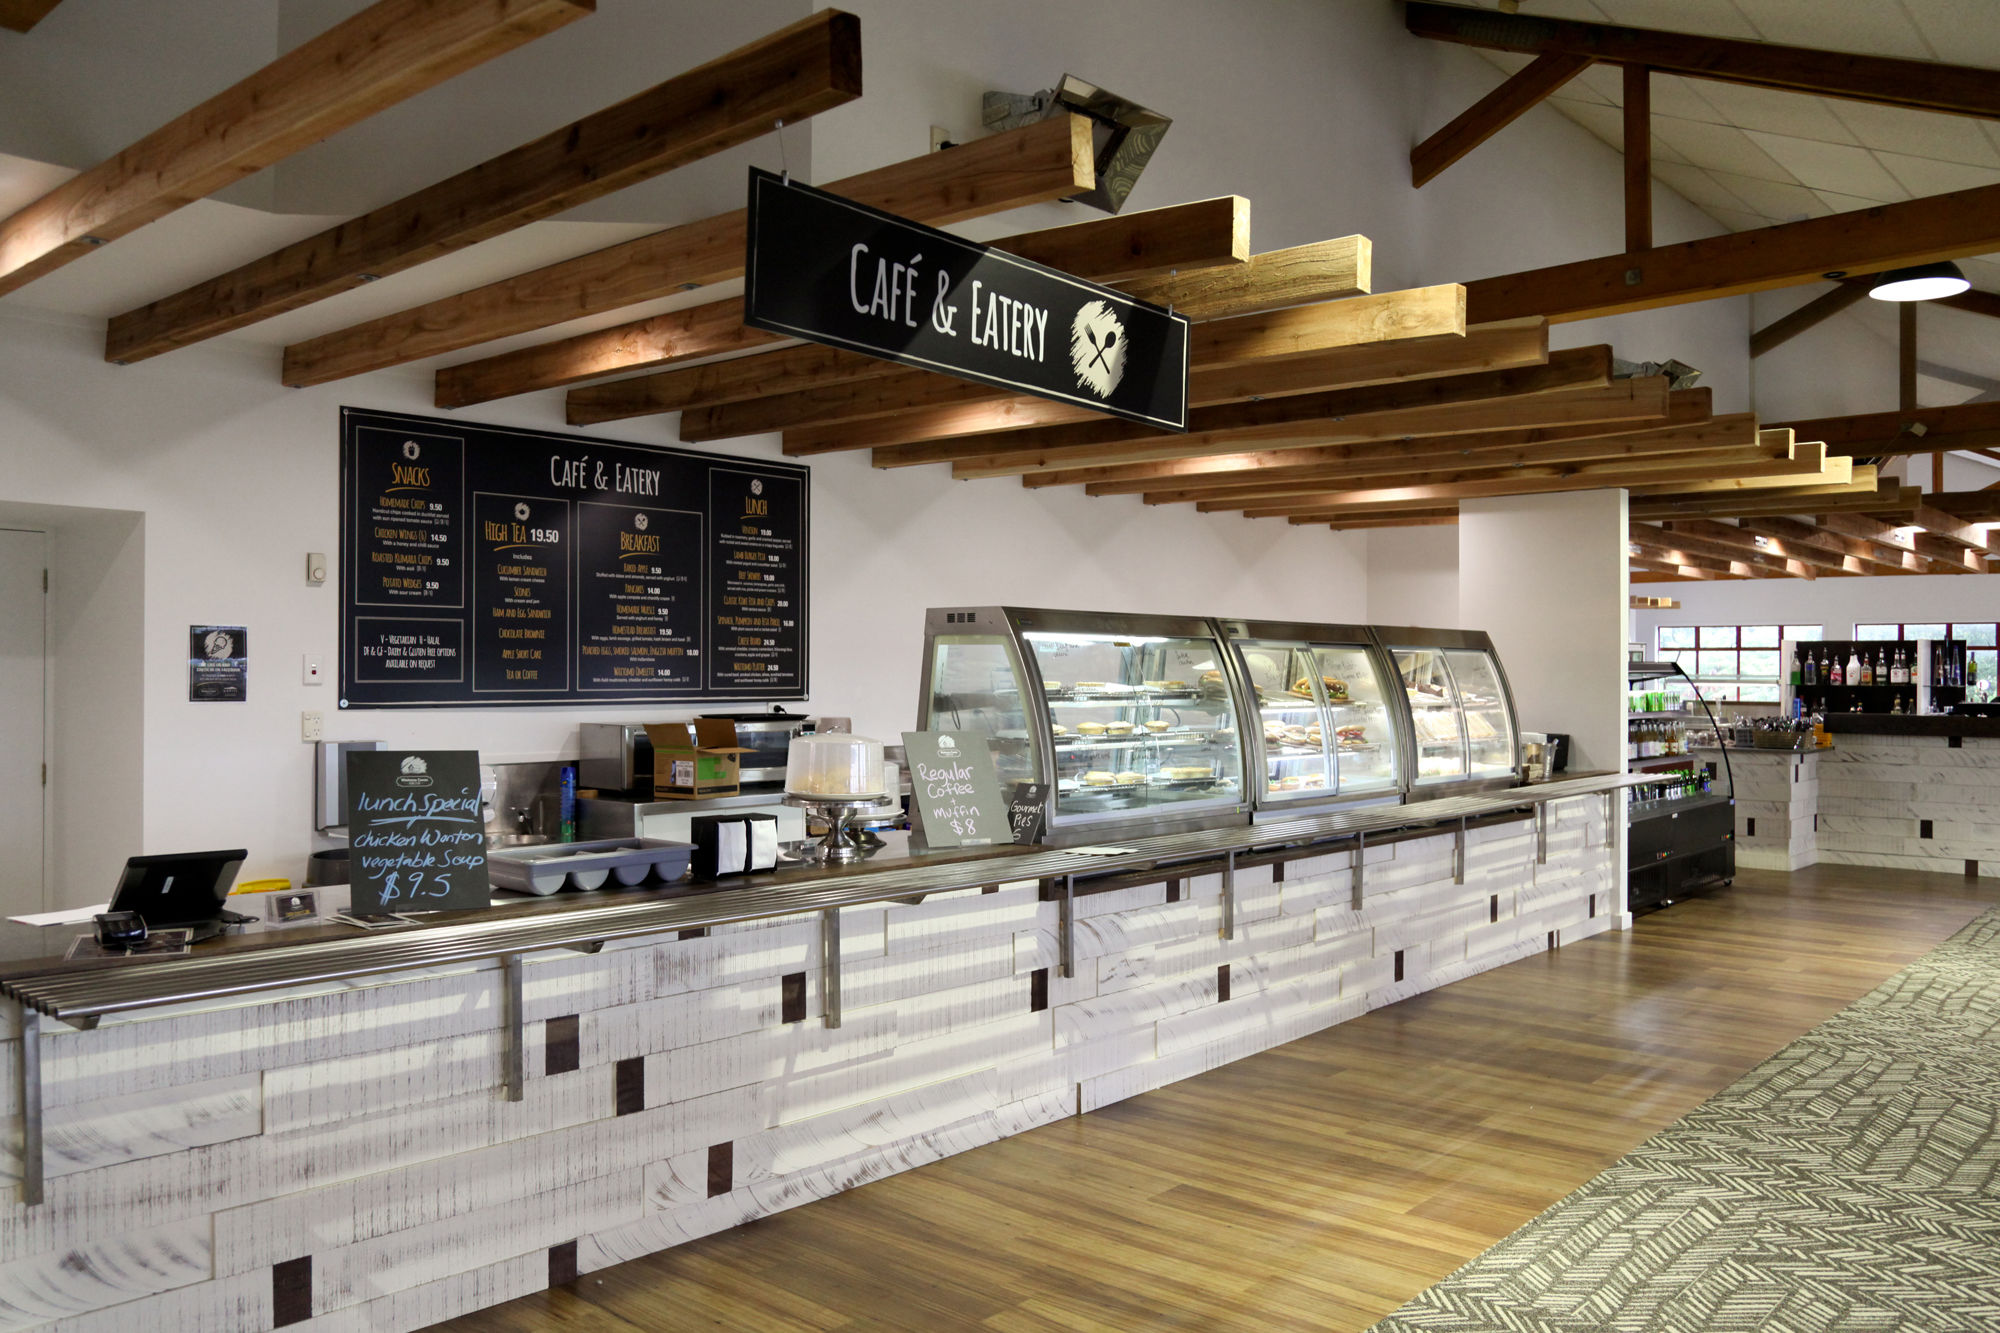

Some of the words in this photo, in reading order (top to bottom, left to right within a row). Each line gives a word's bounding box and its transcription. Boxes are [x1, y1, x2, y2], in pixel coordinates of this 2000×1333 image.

[850, 243, 923, 329] CAFÉ
[932, 270, 958, 337] &
[971, 281, 1049, 364] EATERY
[392, 462, 431, 487] SNACKS
[551, 455, 589, 489] CAFÉ
[594, 460, 609, 490] &
[616, 463, 661, 497] EATERY
[429, 503, 443, 511] 9.50
[745, 496, 768, 516] LUNCH
[375, 526, 398, 539] CHICKEN
[431, 534, 447, 542] 14.50
[485, 520, 508, 542] HIGH
[511, 522, 527, 543] TEA
[530, 528, 560, 544] 19.50
[620, 531, 661, 553] BREAKFAST
[436, 558, 450, 567] 9.50
[382, 576, 402, 588] POTATO
[426, 581, 440, 590] 9.50
[647, 587, 660, 595] 14.00
[517, 608, 526, 618] EGG
[658, 608, 669, 616] 9.50
[659, 628, 672, 636] 19.50
[506, 669, 515, 680] TEA
[522, 669, 538, 680] COFFEE
[917, 761, 974, 788] Regular
[927, 783, 975, 799] Coffee
[358, 792, 417, 812] lunch
[418, 787, 483, 819] Special
[1011, 800, 1044, 814] Gourmet
[1013, 814, 1033, 828] Pies
[362, 851, 436, 879] vegetable
